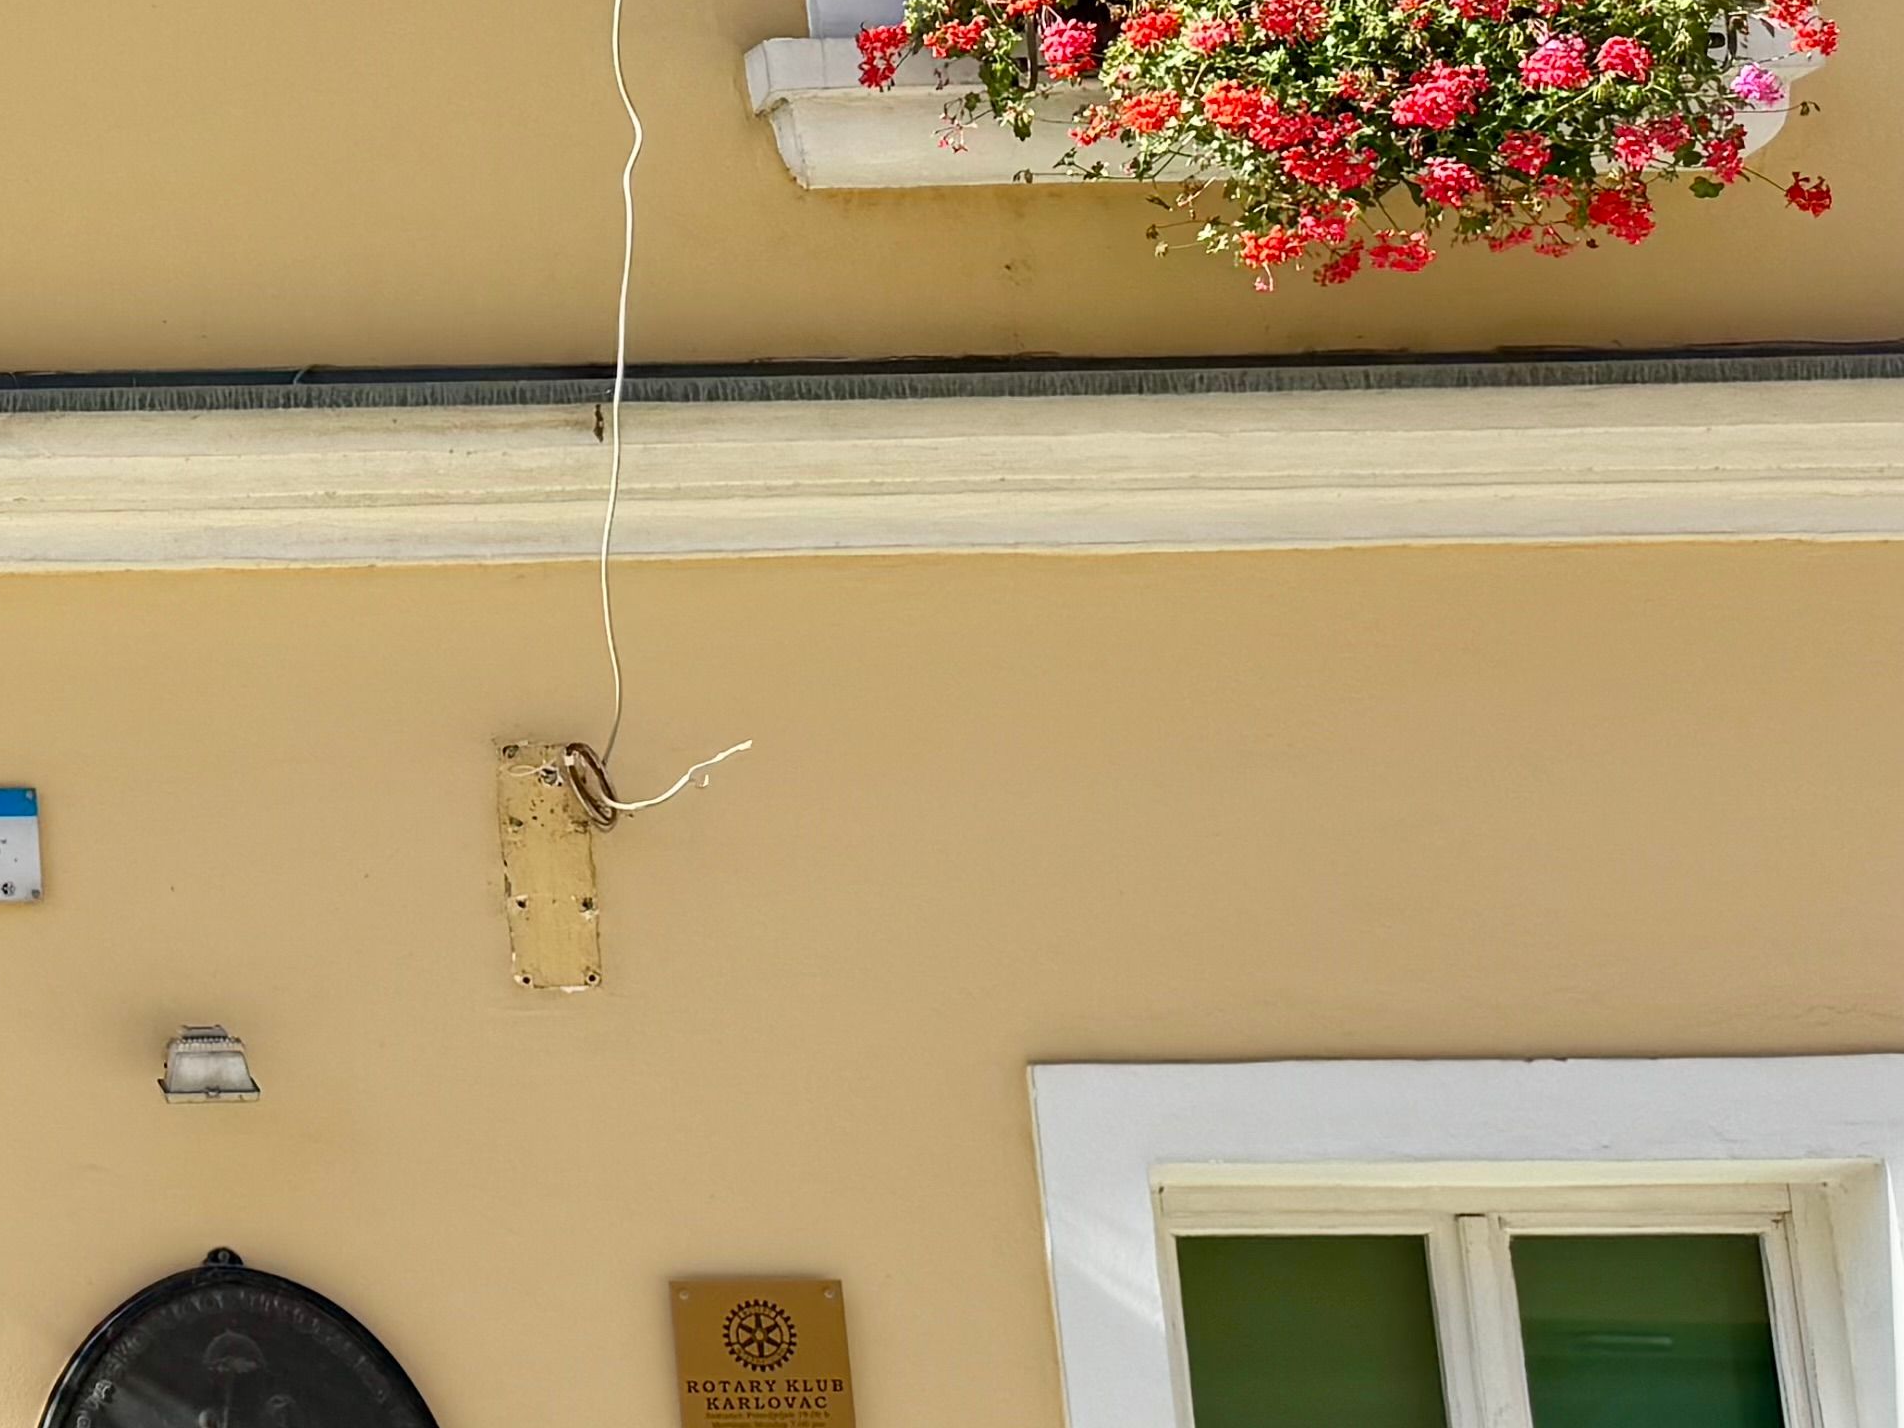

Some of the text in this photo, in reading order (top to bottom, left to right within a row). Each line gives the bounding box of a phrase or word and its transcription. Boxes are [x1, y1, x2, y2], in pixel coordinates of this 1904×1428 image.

[687, 1378, 844, 1394] ROTARY KLUB
[706, 1396, 828, 1411] KARLOVAC
